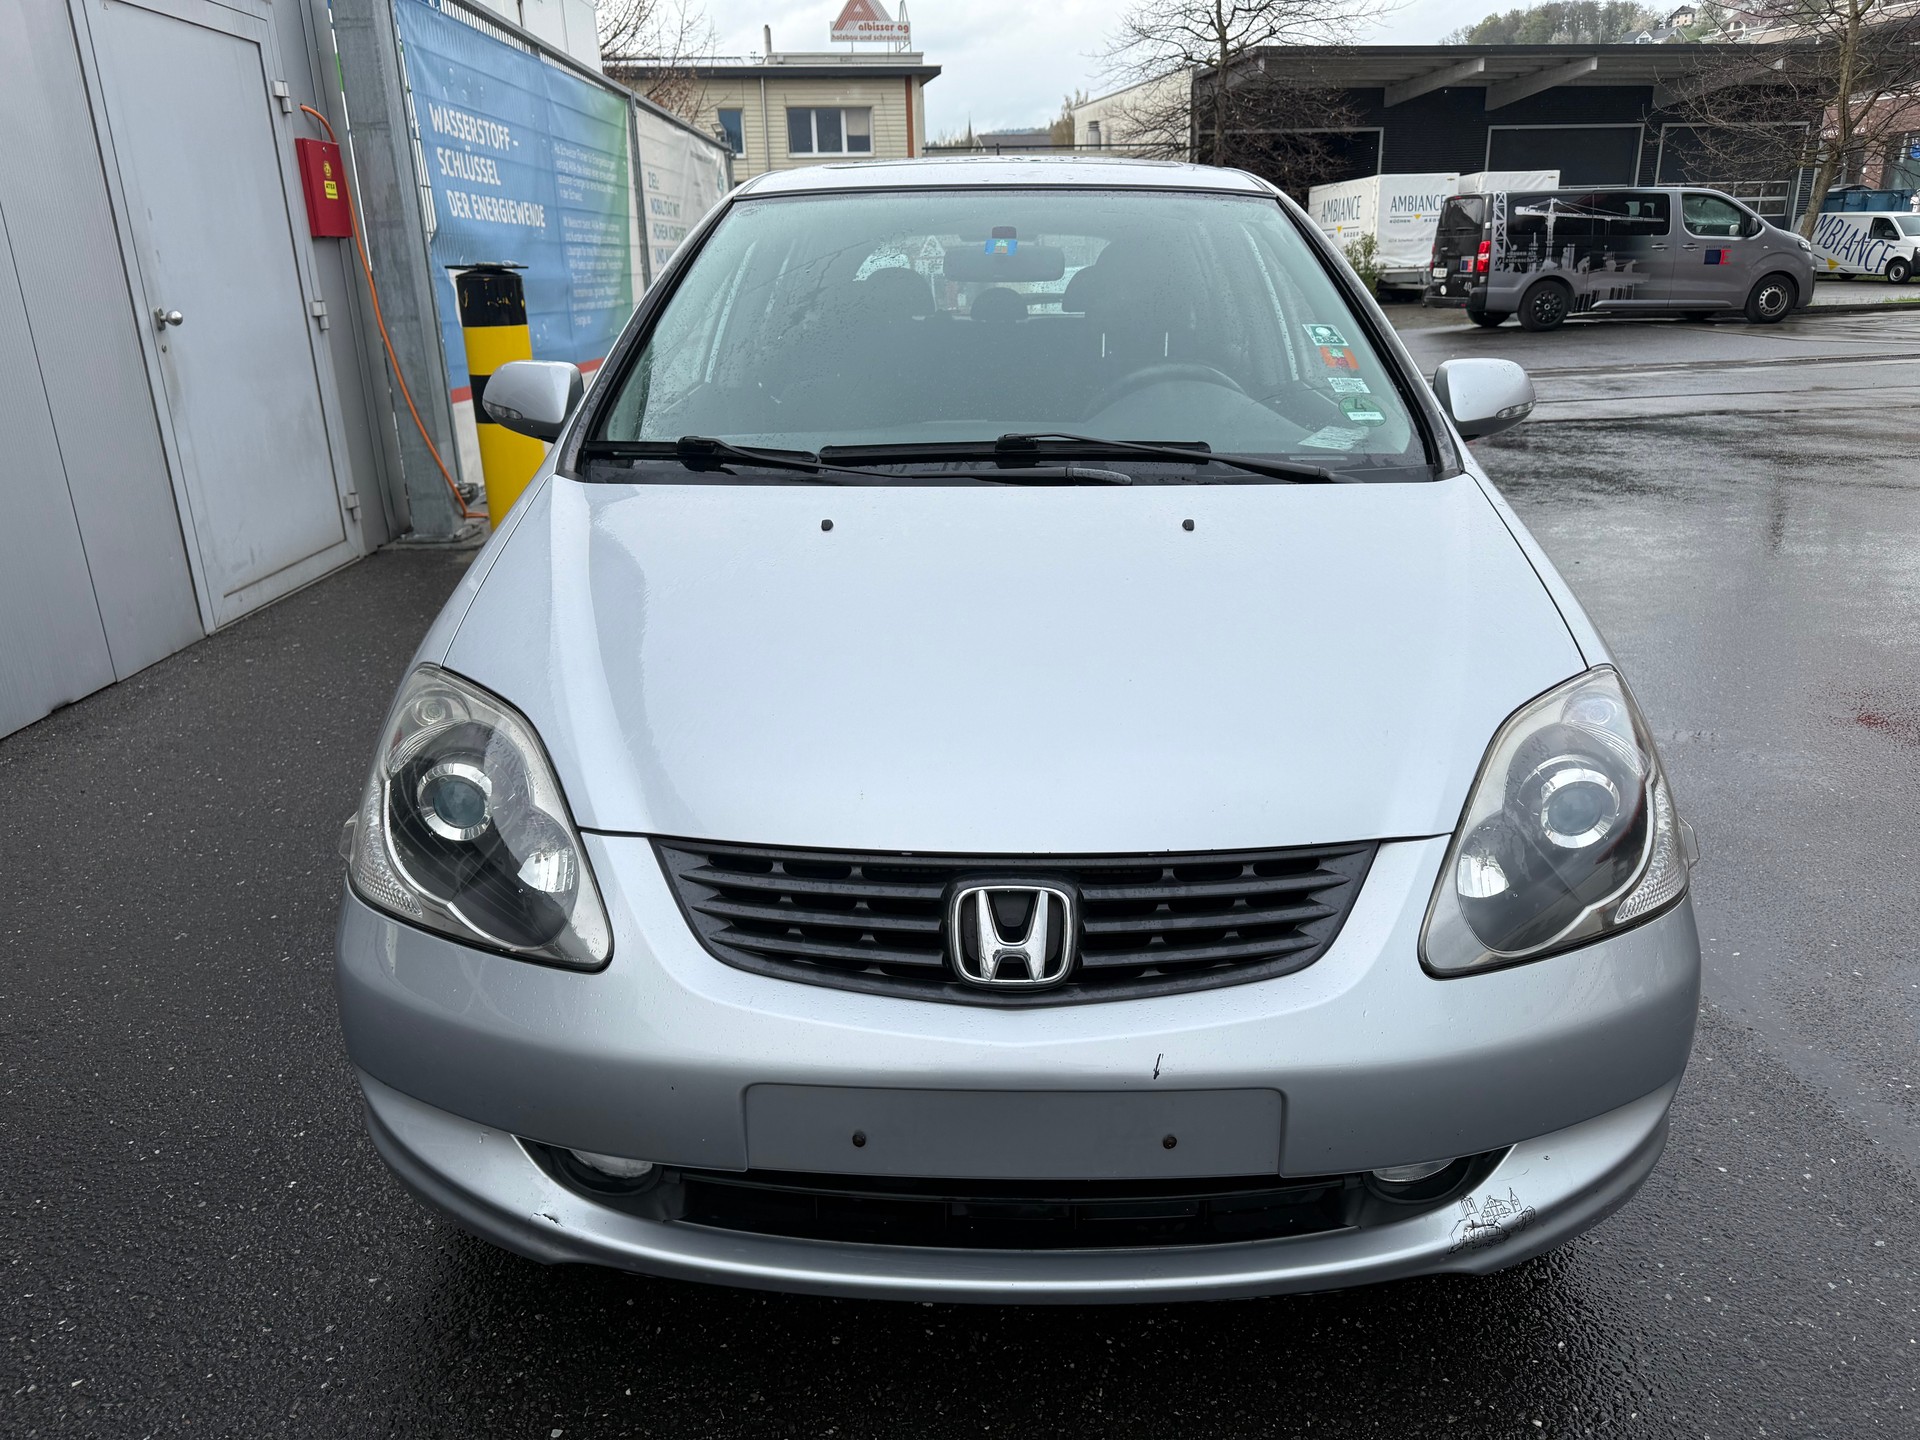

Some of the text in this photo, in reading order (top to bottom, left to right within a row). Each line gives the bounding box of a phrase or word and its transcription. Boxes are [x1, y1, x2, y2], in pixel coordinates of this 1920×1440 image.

[436, 144, 502, 186] SCHLÜSSEL
[446, 189, 473, 219] DER
[470, 193, 546, 228] ENERGIEWENDE
[1320, 195, 1362, 223] AMBIANCE
[1389, 194, 1447, 212] AMBIANCE
[1812, 213, 1896, 274] MBIANCE
